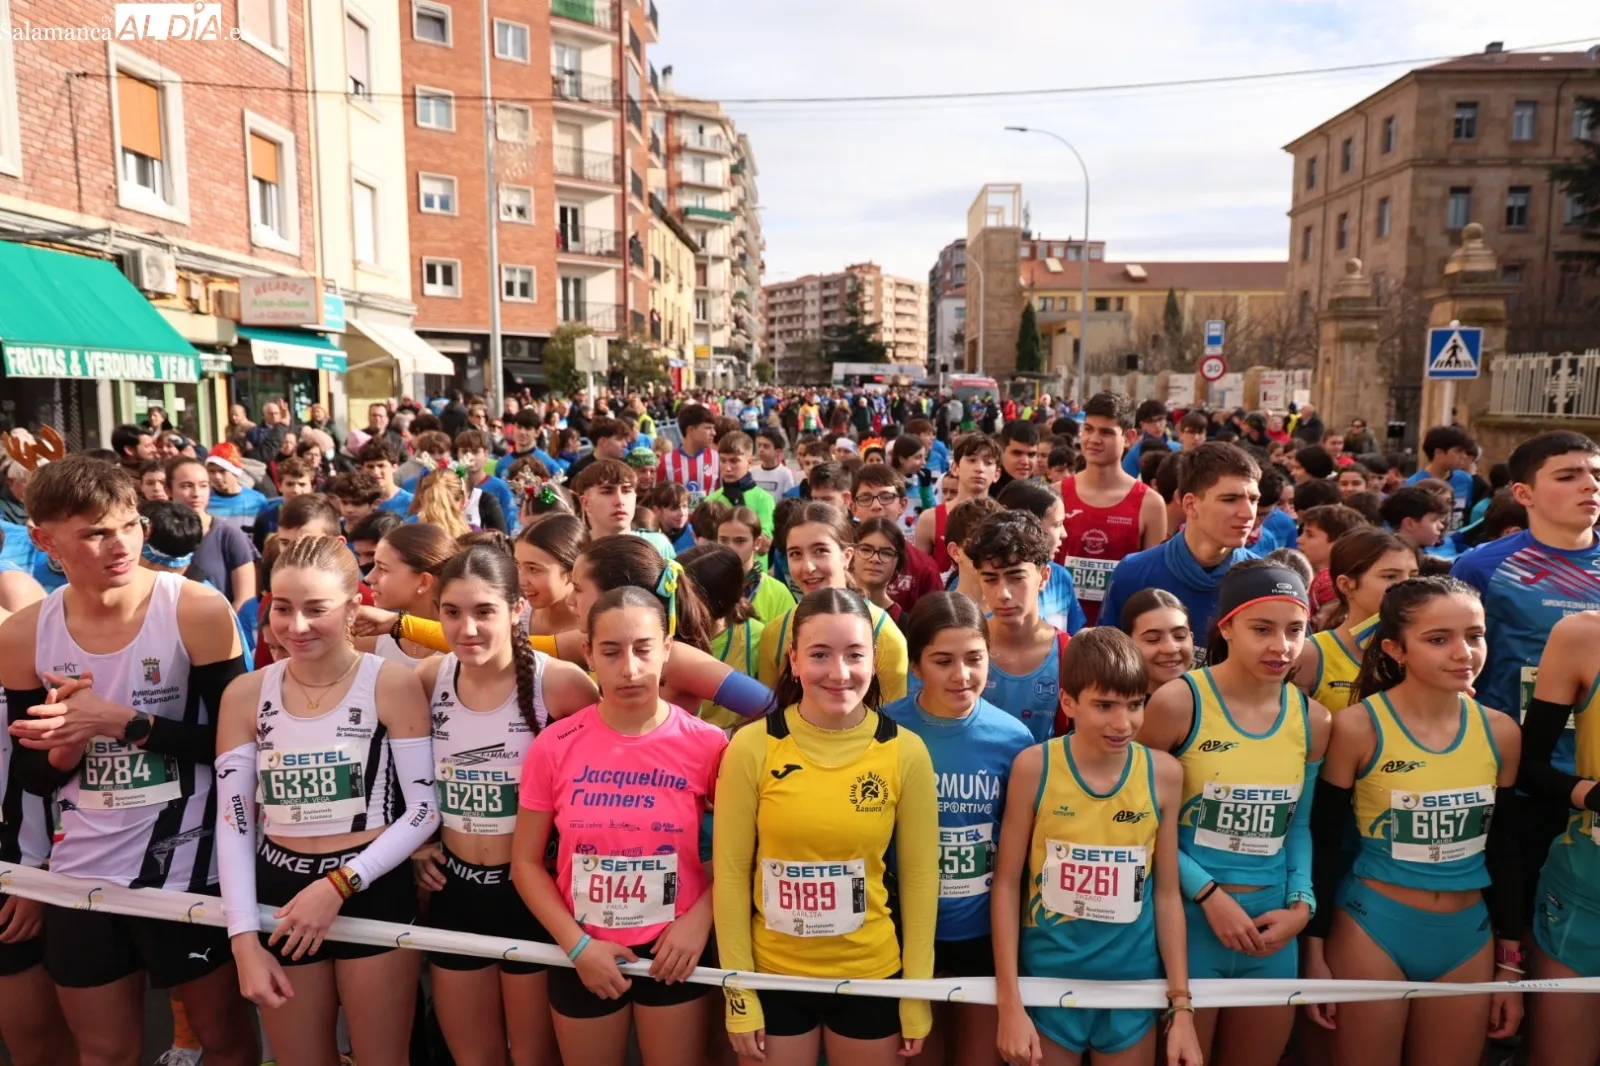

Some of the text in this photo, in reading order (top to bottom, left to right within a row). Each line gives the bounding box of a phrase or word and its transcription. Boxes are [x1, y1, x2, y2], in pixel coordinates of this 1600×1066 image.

[253, 281, 306, 297] HELADOS
[6, 346, 67, 376] FRUTAS
[70, 350, 83, 377] &
[84, 350, 156, 379] VERDURAS
[158, 355, 198, 382] VERA
[1206, 362, 1221, 374] 30
[1073, 568, 1106, 588] 6146
[131, 686, 180, 698] Ayuntamiento
[132, 694, 180, 707] de Salamanca
[282, 750, 351, 767] SETEL
[85, 754, 152, 786] 6284
[454, 769, 516, 782] SETEL
[270, 767, 338, 800] 6338
[573, 765, 688, 791] Jacqueline
[279, 796, 331, 806] CANDELA VEGA
[445, 781, 503, 813] 6293
[849, 784, 858, 805] Club
[1231, 788, 1293, 801] SETEL
[1422, 791, 1487, 808] SETEL
[303, 807, 332, 815] Ayuntamiento
[855, 804, 882, 813] Zamora
[938, 801, 993, 815] EPORTIVO
[1216, 802, 1277, 833] 6316
[1412, 808, 1470, 840] 6157
[1215, 827, 1239, 836] MARTA
[1431, 837, 1454, 846] LAURA
[260, 841, 315, 875] NIKE
[1071, 848, 1139, 863] SETEL
[1441, 847, 1466, 855] Ayuntamiento
[1446, 852, 1466, 860] Salamanca
[446, 856, 504, 885] NIKE
[600, 859, 667, 872] SETEL
[786, 865, 855, 878] SETEL
[1060, 862, 1119, 897] 6261
[589, 873, 648, 904] 6144
[778, 880, 837, 912] 6189
[1075, 893, 1102, 902] THIAGO
[605, 903, 629, 911] PAULA
[1086, 906, 1116, 914] Ayuntamiento
[791, 910, 823, 919] CARLITA
